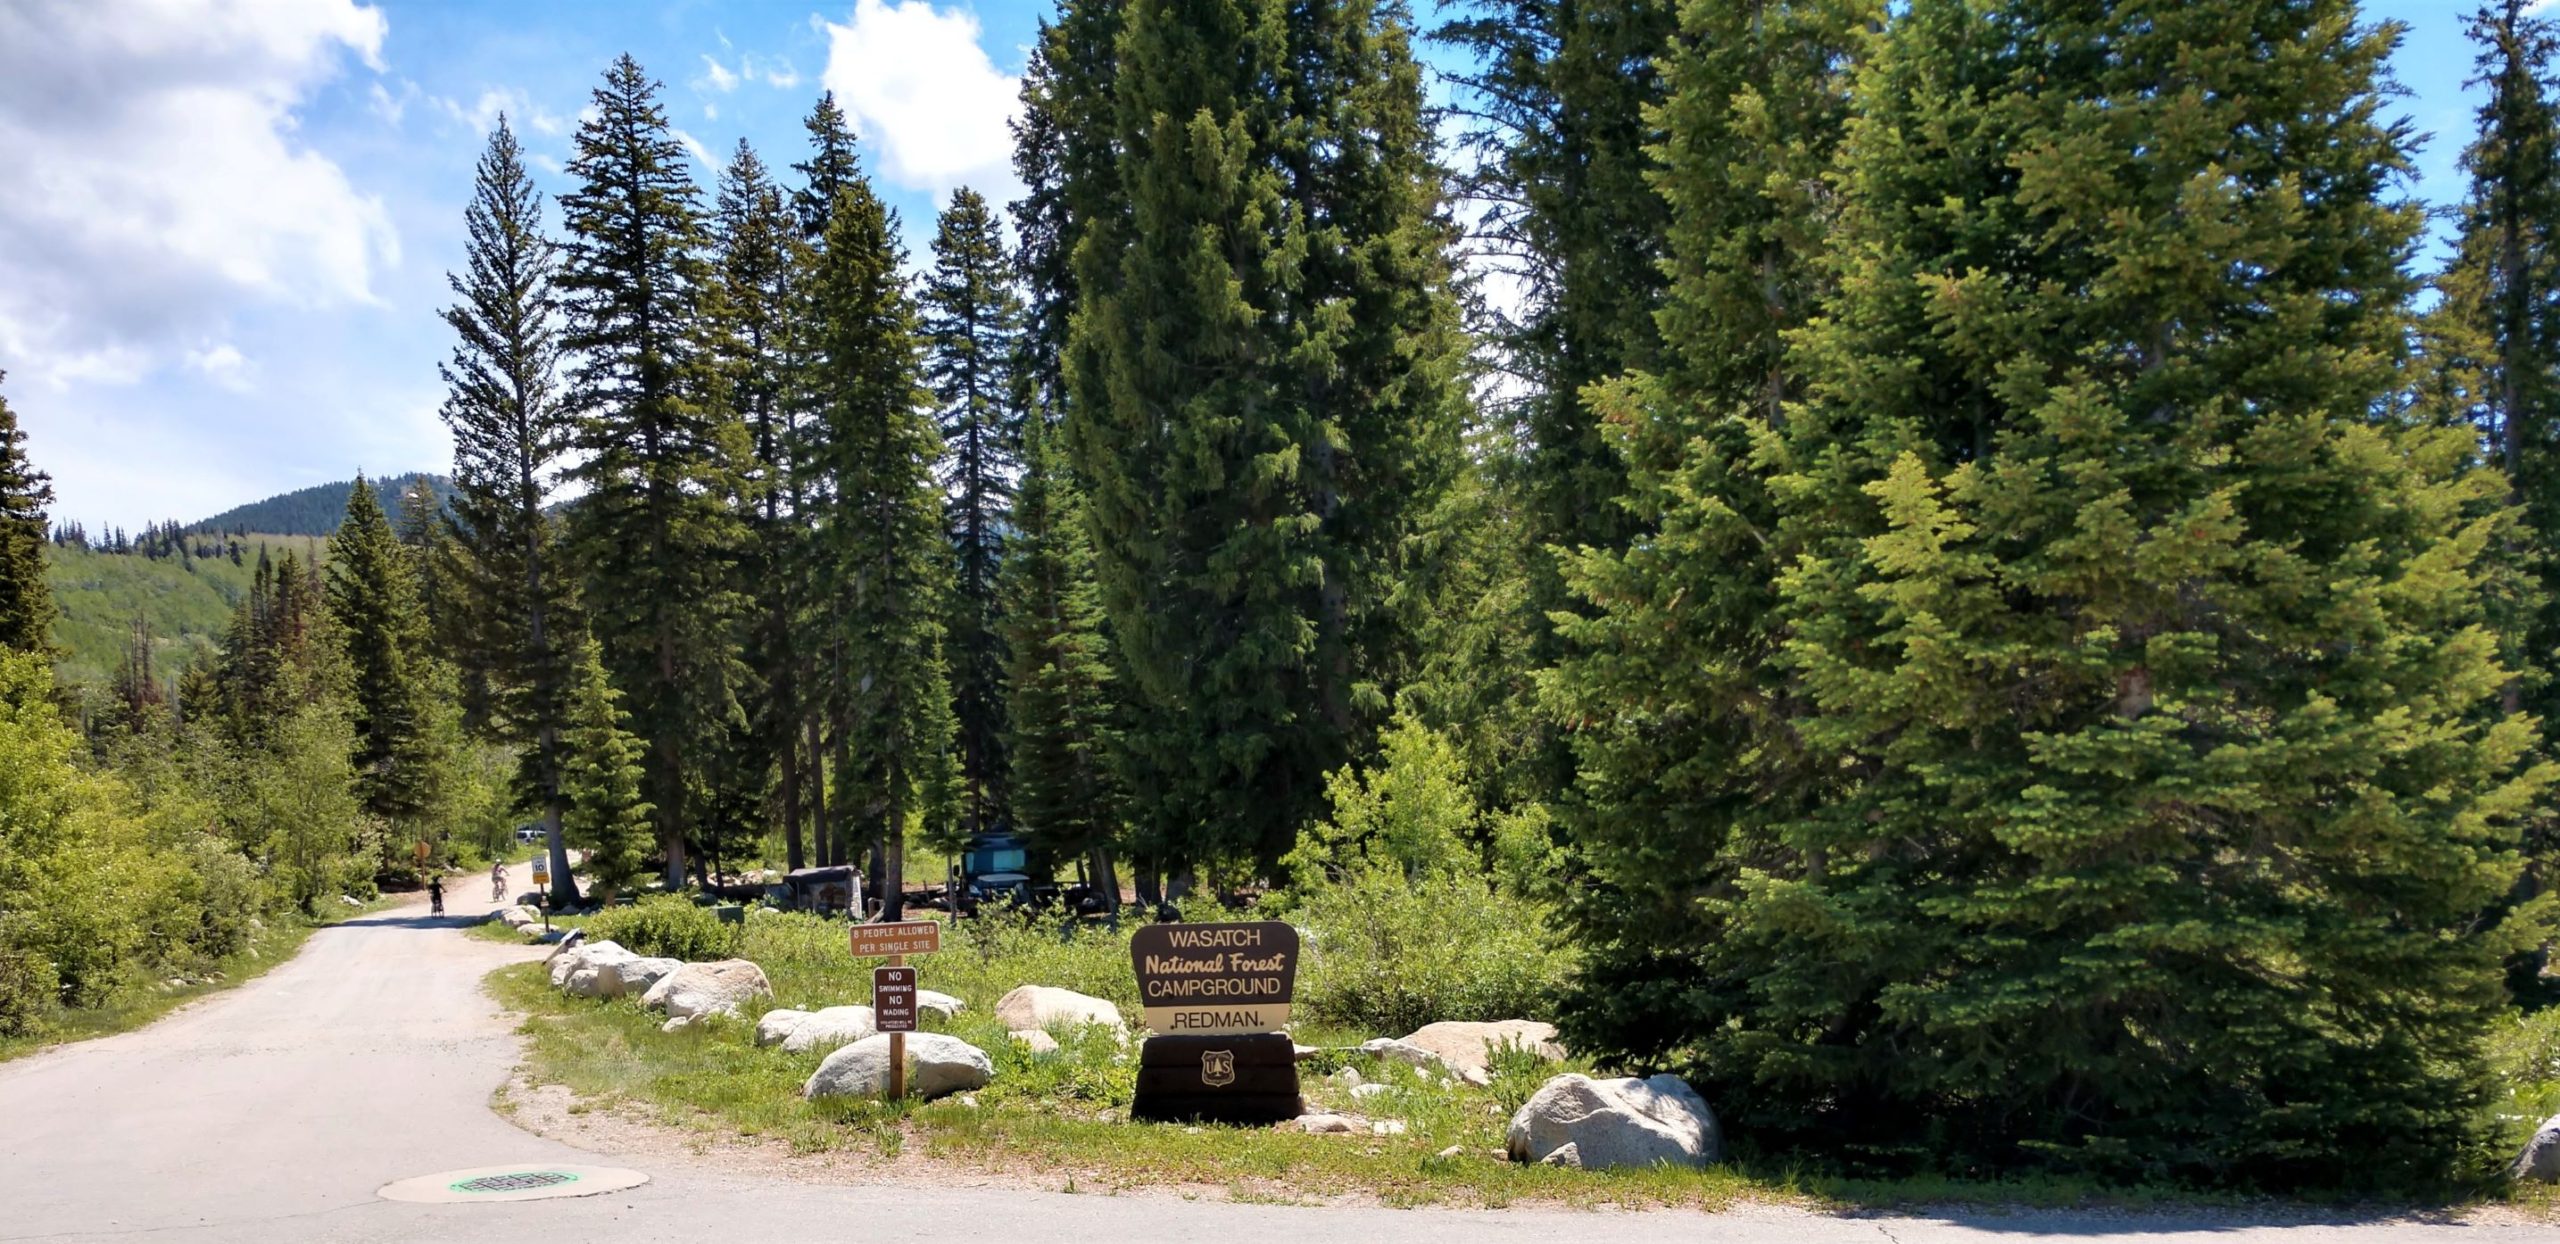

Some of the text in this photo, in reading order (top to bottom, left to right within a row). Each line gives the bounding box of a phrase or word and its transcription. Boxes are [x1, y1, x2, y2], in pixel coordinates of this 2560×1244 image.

[852, 925, 935, 939] 8 PEOPLE ALLOWED
[1168, 929, 1261, 948] WASATCH
[860, 940, 931, 953] PER SINGLE SITE
[1145, 952, 1286, 975] National Forest
[888, 971, 902, 981] NO
[1148, 977, 1281, 998] CAMPGROUND
[889, 995, 903, 1005] NO
[882, 1008, 909, 1016] WADING
